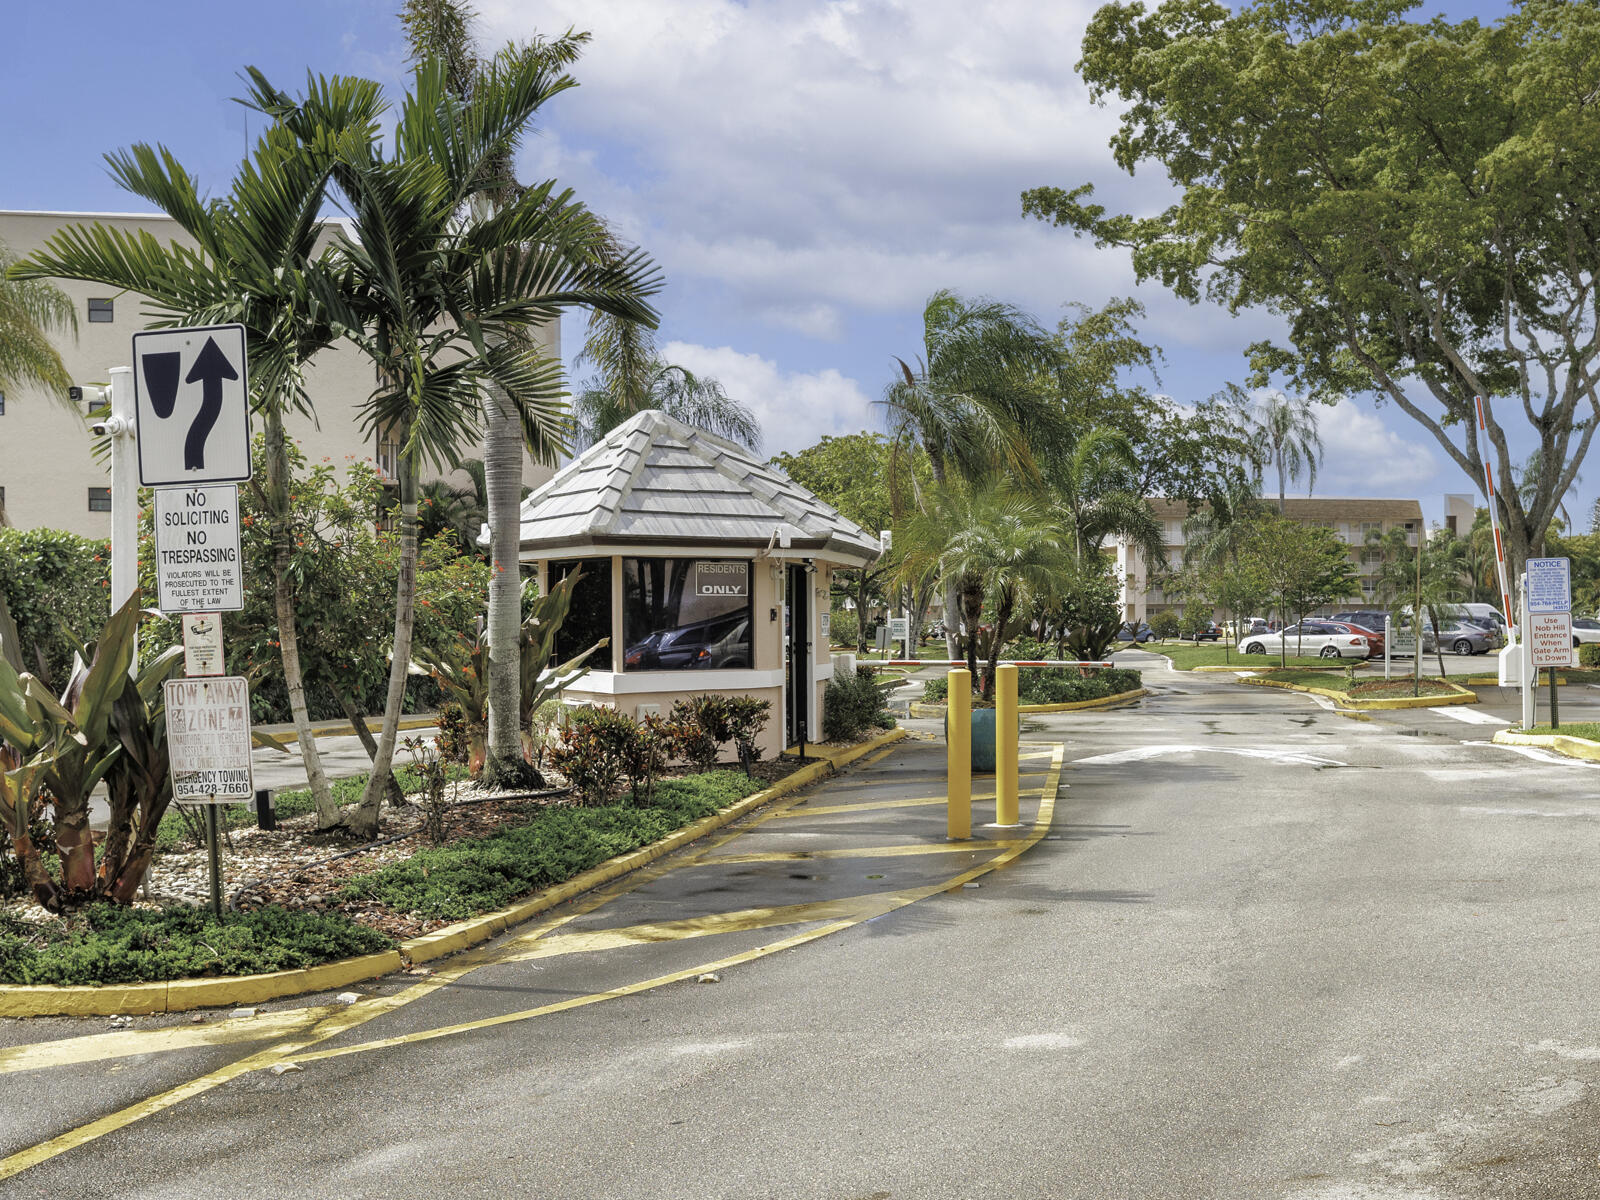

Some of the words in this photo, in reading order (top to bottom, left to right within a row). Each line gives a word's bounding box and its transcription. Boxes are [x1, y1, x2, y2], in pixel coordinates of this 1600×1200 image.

[186, 493, 206, 507] NO
[165, 510, 229, 526] SOLICITING
[187, 531, 206, 545] NO
[162, 548, 236, 564] TRESPASSING
[166, 570, 202, 578] VIOLATORS
[698, 564, 746, 574] RESIDENTS
[165, 580, 207, 588] PROSECUTED
[702, 586, 742, 594] ONLY
[172, 589, 199, 597] FULLEST
[169, 684, 198, 706] TOW
[206, 682, 242, 704] AWAY
[188, 708, 227, 732] ZONE
[178, 783, 248, 794] 954-428-7660
